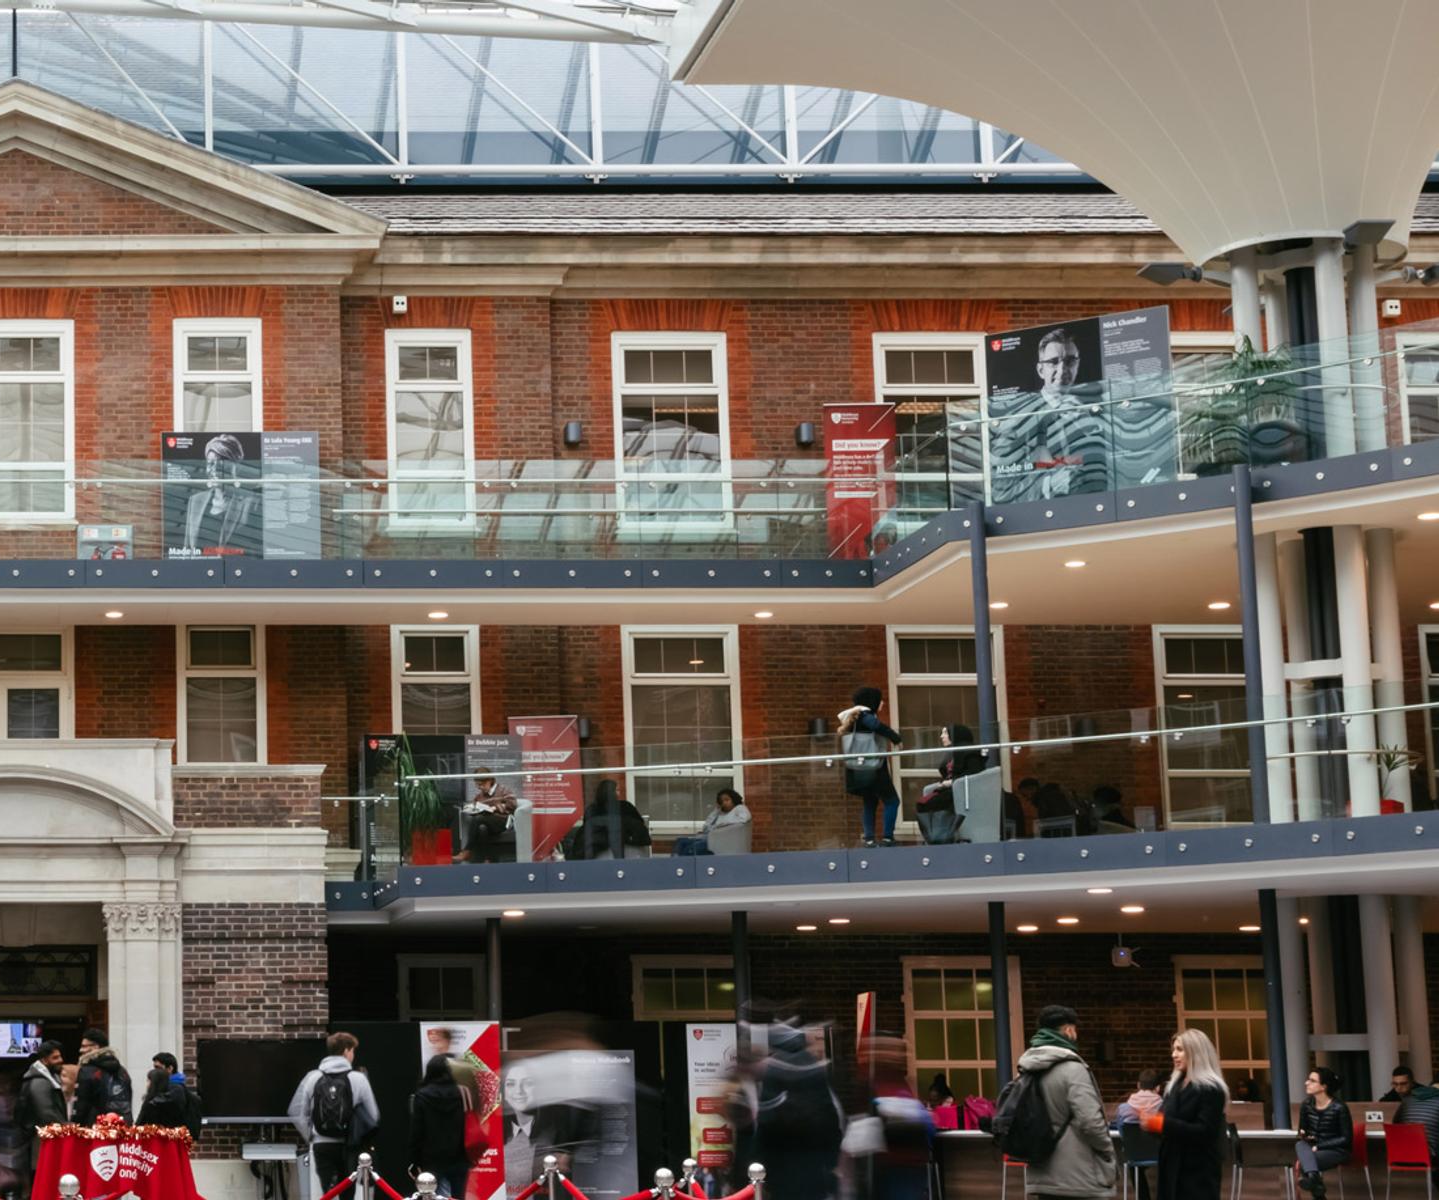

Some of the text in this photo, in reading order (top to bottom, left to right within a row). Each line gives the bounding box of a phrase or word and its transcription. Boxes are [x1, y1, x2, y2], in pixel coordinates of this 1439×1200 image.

[996, 462, 1022, 474] Made
[1023, 461, 1034, 471] in
[168, 547, 191, 556] Made
[192, 547, 202, 556] in
